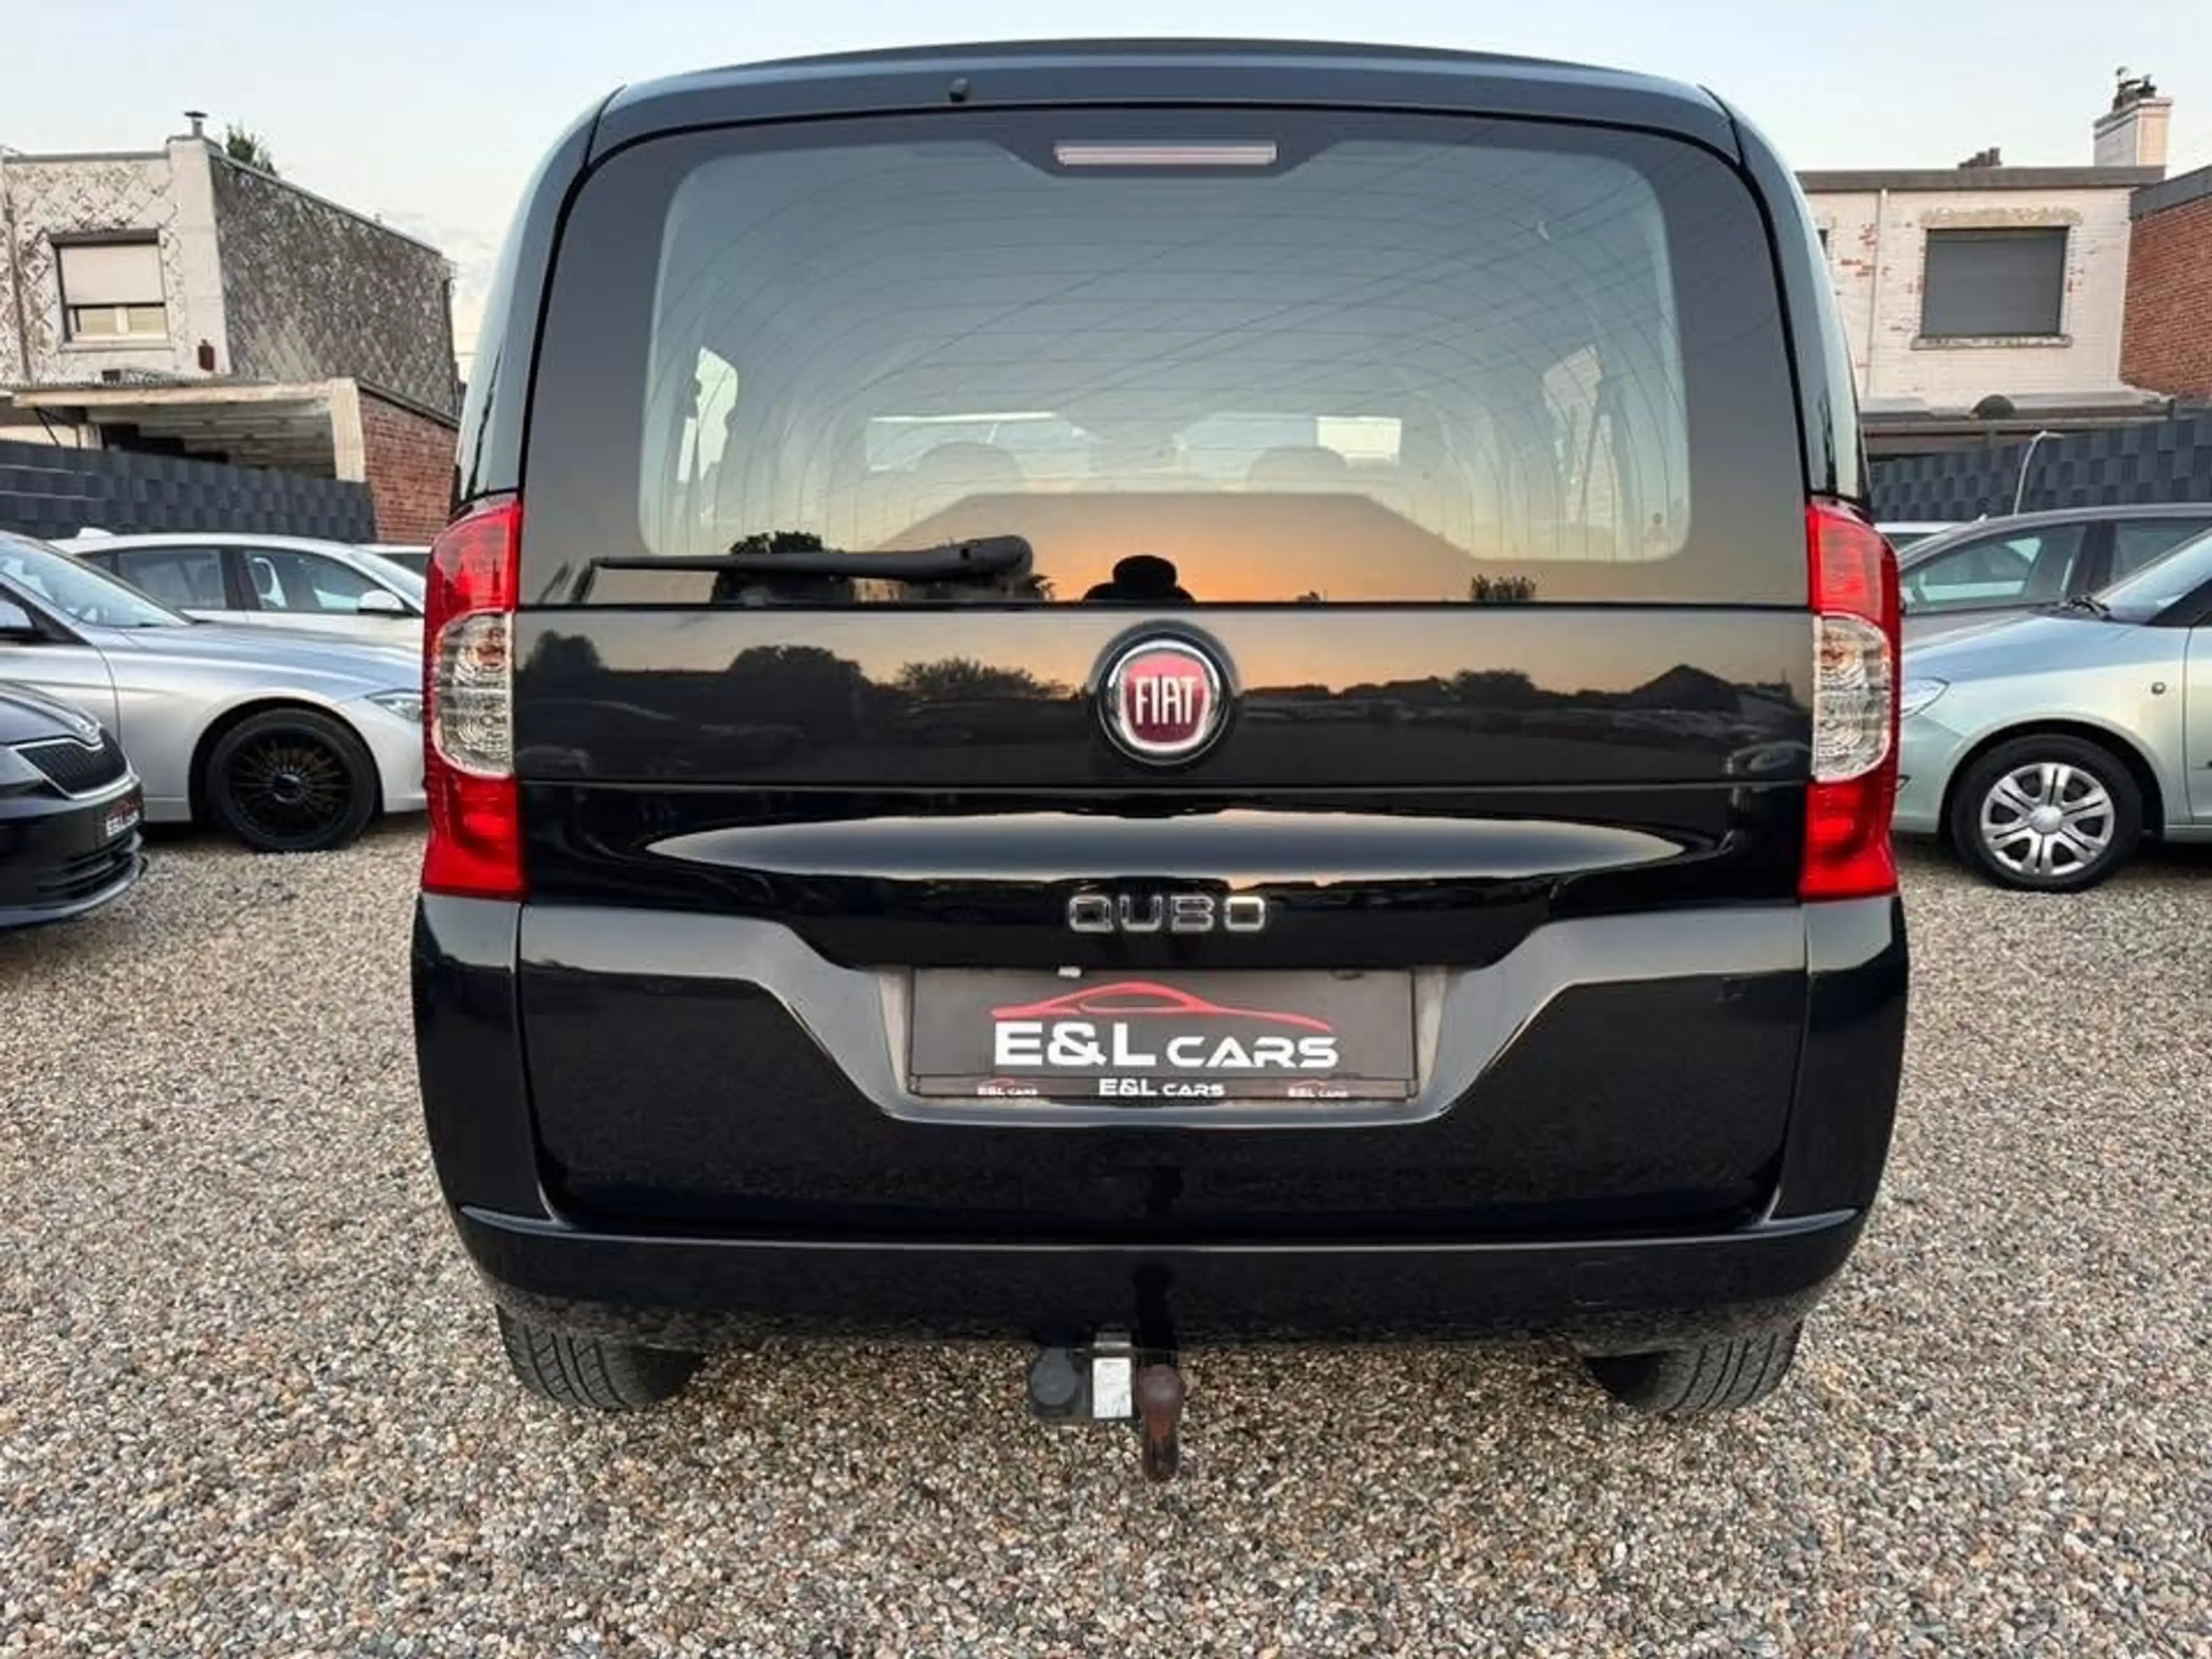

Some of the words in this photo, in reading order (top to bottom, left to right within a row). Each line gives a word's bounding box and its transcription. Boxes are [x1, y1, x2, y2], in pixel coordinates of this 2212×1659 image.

[1135, 676, 1198, 725] FIAT
[1069, 895, 1265, 932] QUBO
[994, 1021, 1157, 1066] E&L
[1166, 1036, 1339, 1068] CARS
[1099, 1078, 1158, 1096] E&L
[1162, 1082, 1226, 1097] CARS
